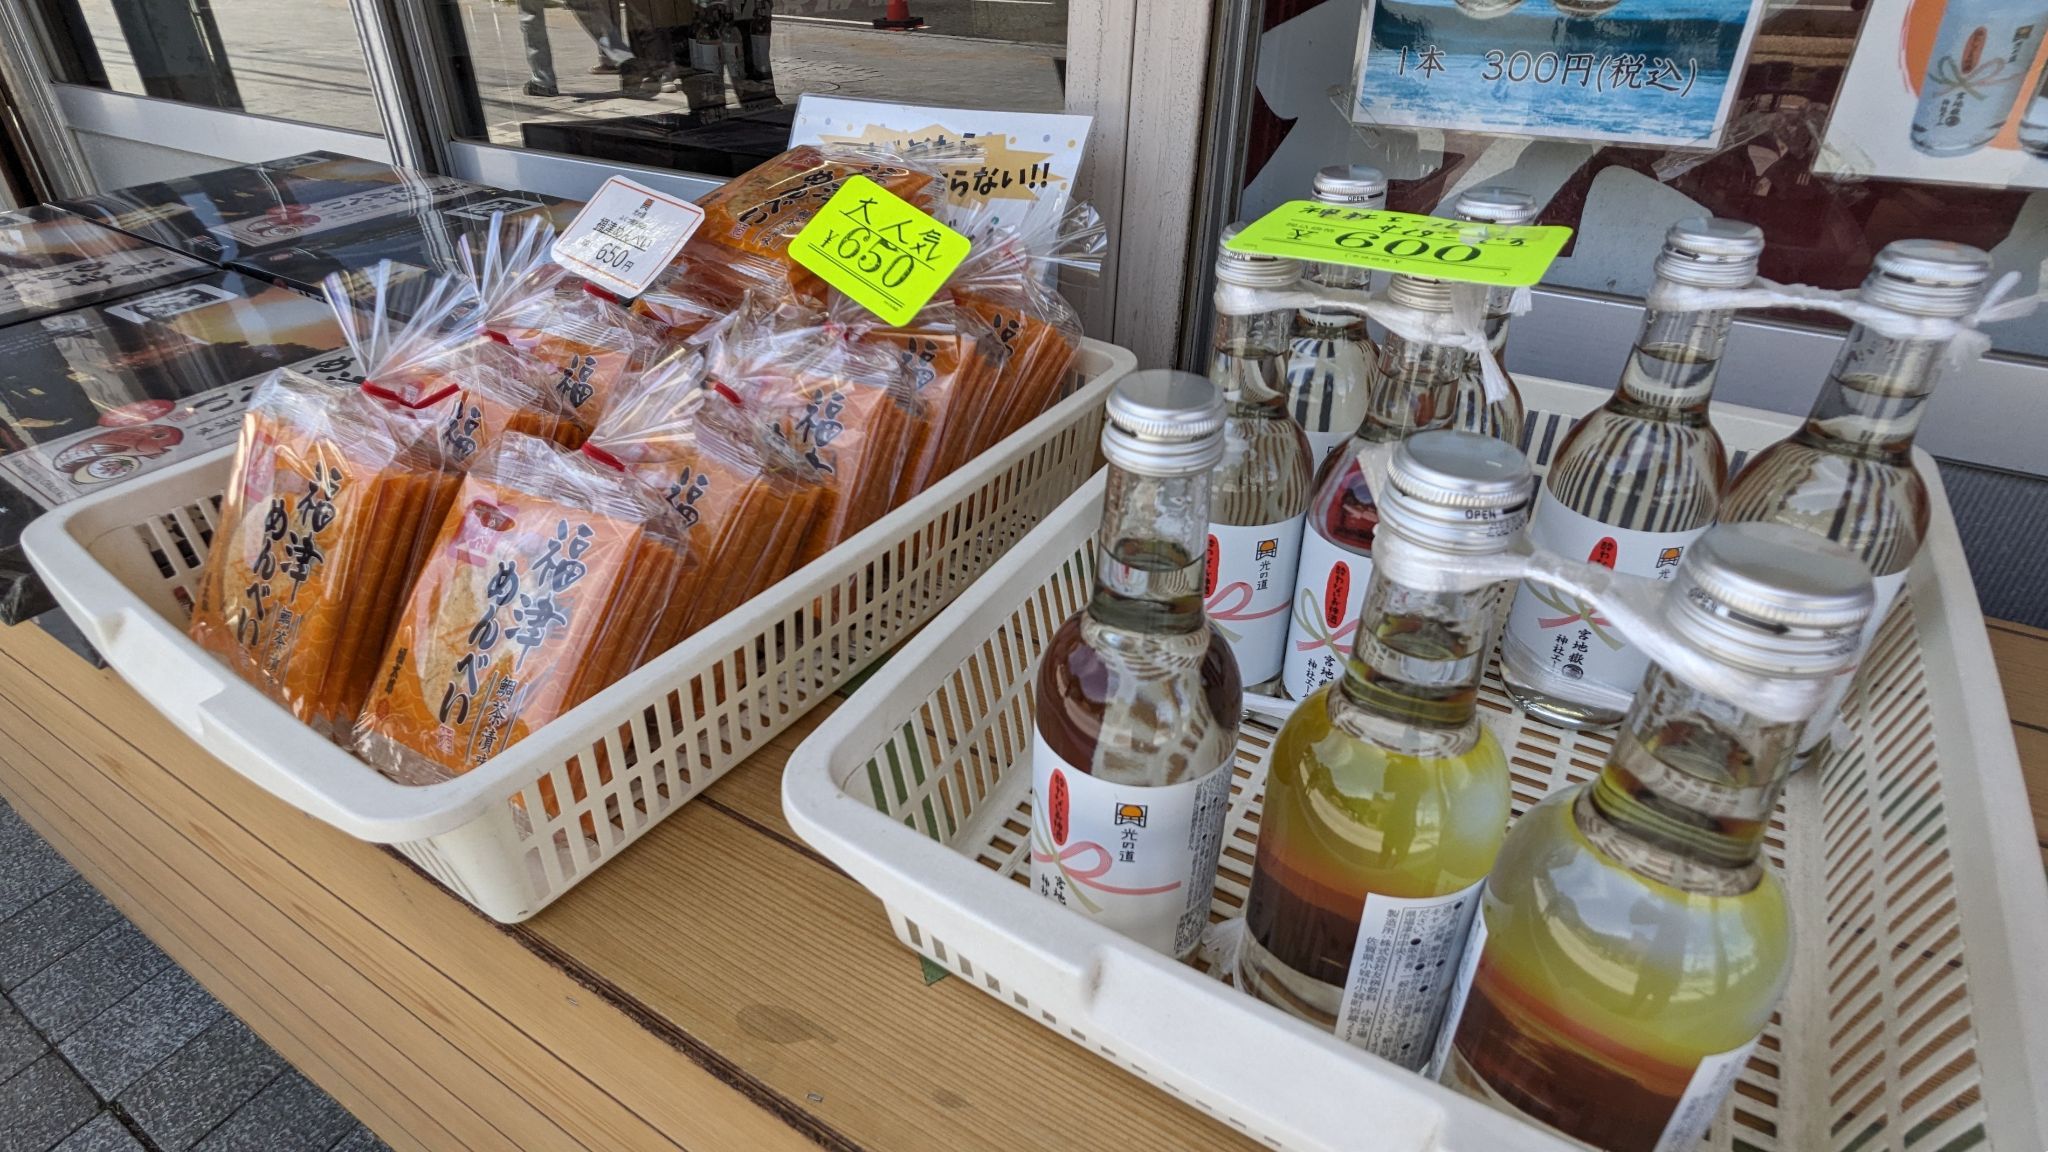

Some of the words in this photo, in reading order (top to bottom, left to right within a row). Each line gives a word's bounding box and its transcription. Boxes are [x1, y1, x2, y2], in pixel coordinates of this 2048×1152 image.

[1399, 45, 1447, 79] 1本
[1481, 49, 1698, 98] 300円(税込)
[940, 162, 1051, 197] らない!!
[846, 197, 943, 262] 大人気
[595, 242, 635, 273] 650円
[820, 226, 916, 288] ¥650
[1465, 508, 1498, 520] OPEN
[503, 518, 597, 673] 福津
[1256, 561, 1272, 591] 光の道
[438, 559, 521, 725] めんべい
[1550, 633, 1569, 672] 神社エー
[1119, 828, 1139, 864] 光の道
